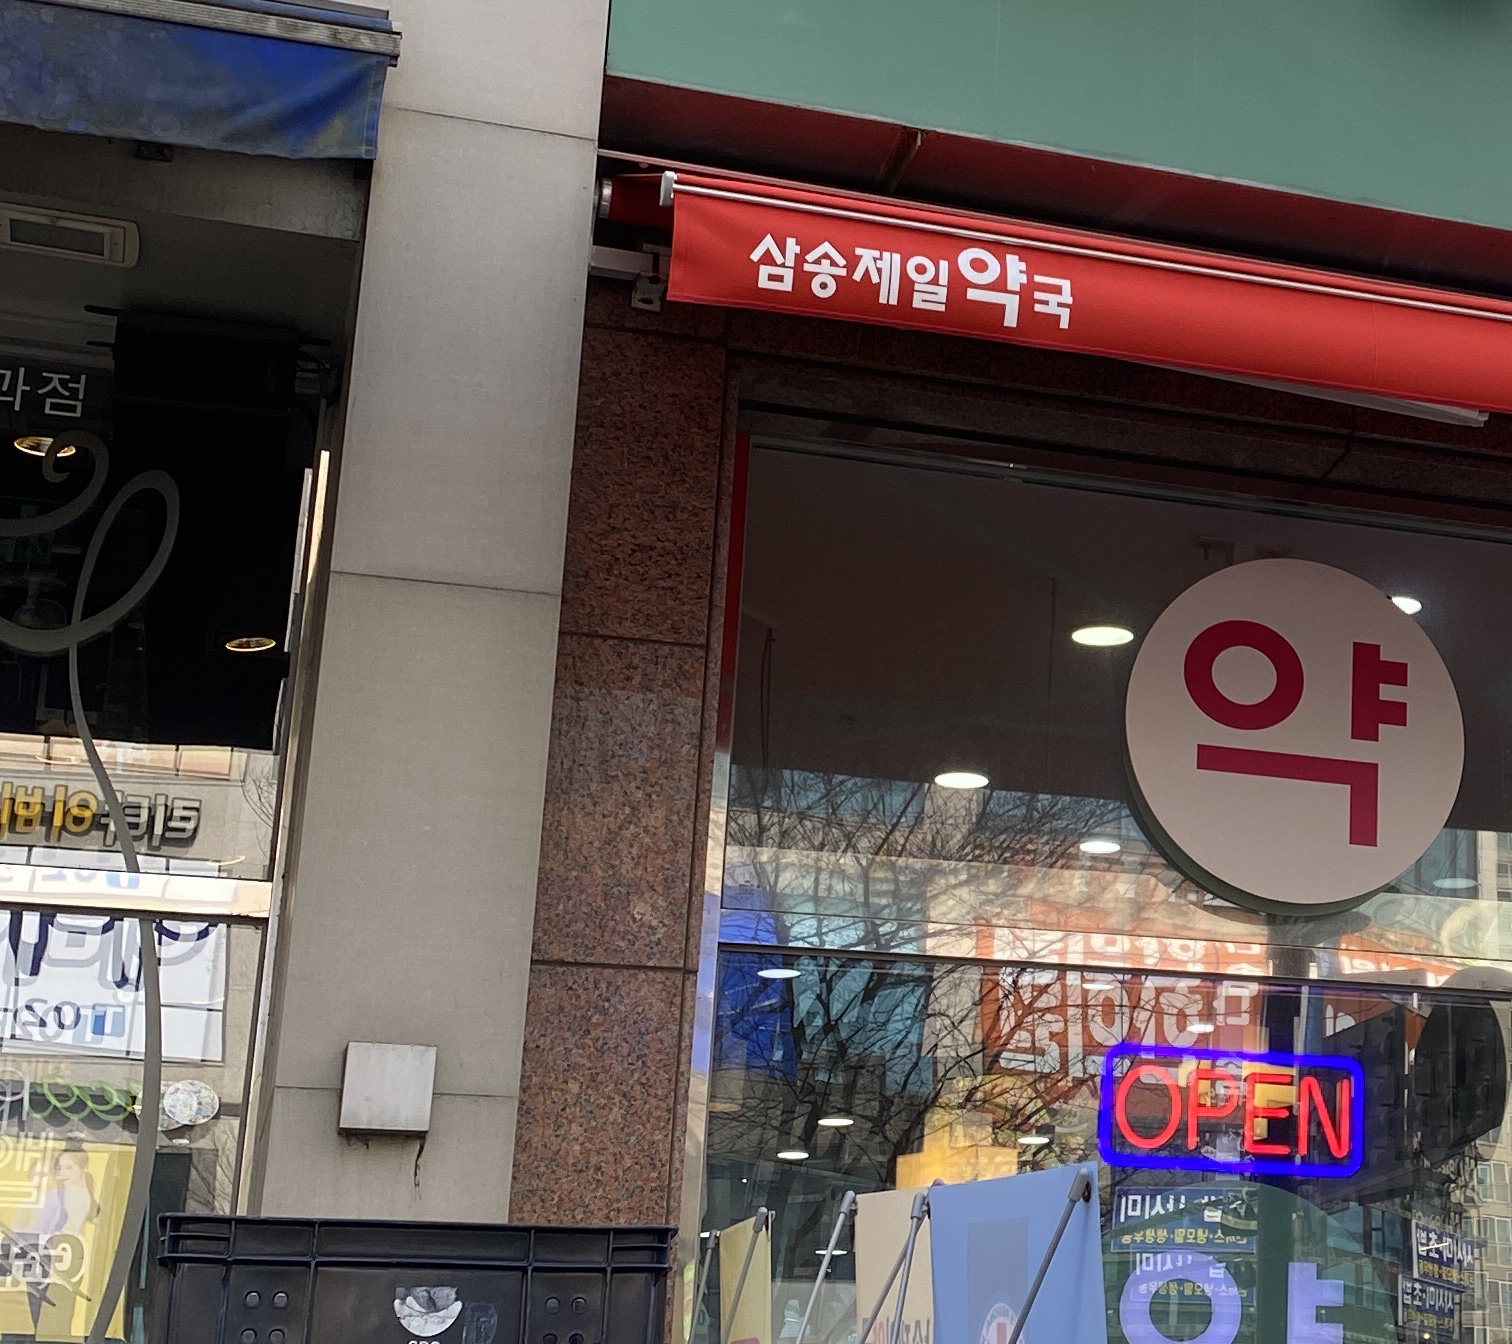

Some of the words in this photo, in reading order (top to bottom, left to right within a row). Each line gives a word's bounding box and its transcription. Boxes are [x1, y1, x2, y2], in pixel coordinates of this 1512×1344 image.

[748, 232, 1075, 330] 삼송제일약국
[1183, 618, 1409, 848] 약
[1114, 1063, 1352, 1160] OPEN
